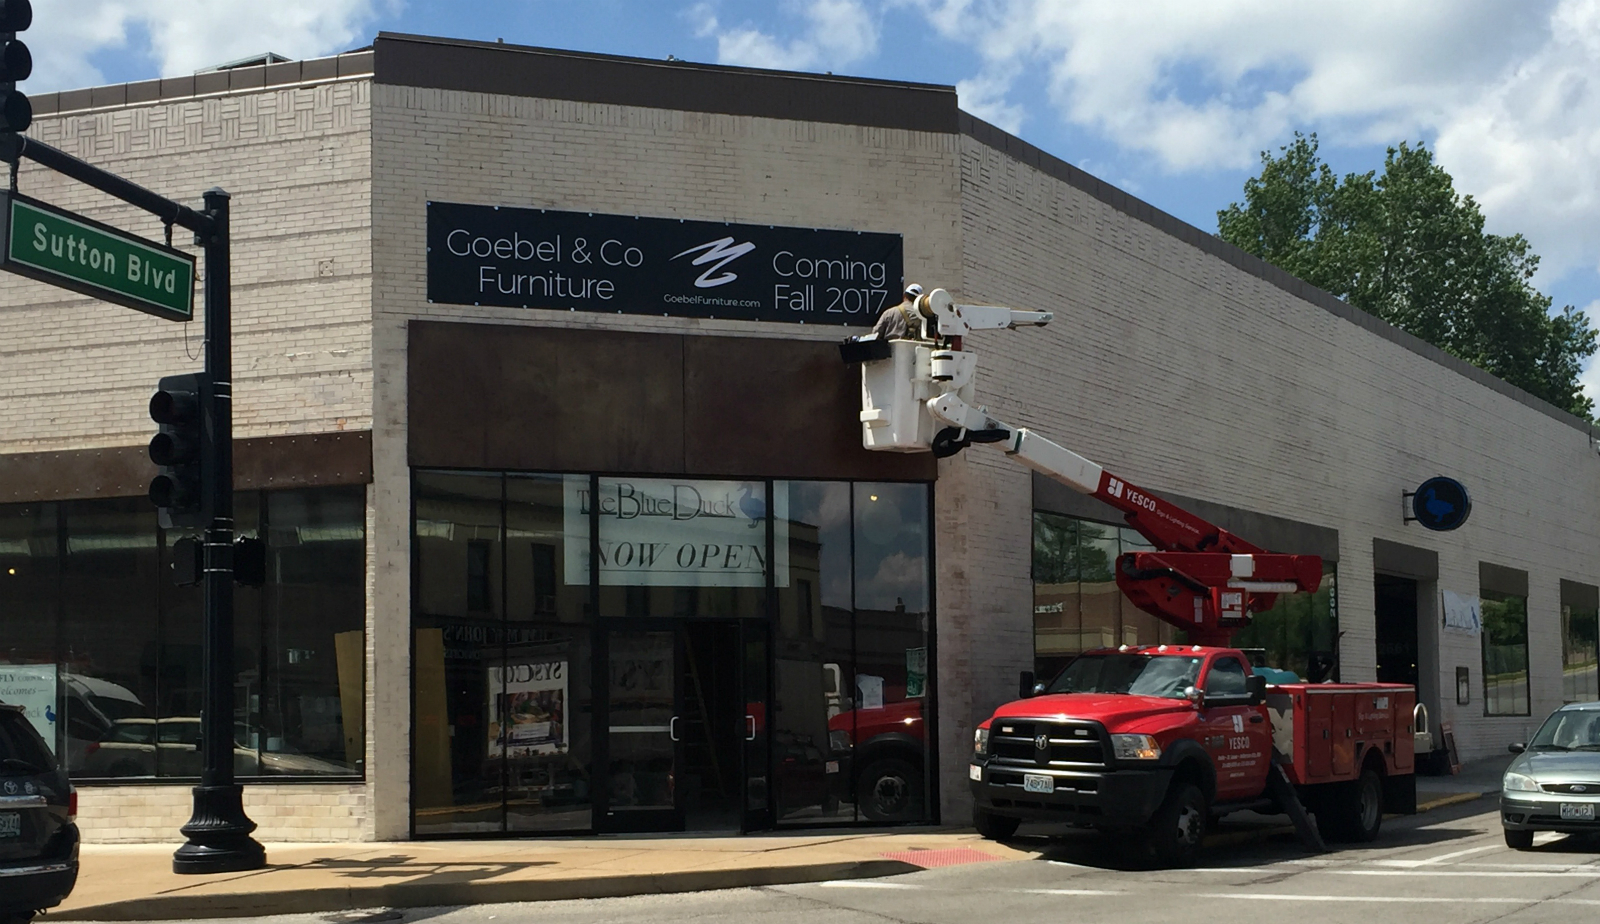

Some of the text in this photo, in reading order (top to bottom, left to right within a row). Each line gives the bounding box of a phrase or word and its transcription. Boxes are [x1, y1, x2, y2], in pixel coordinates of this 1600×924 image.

[32, 222, 176, 295] Sutton Blvd
[446, 229, 644, 267] Goebel & Co
[479, 266, 615, 300] Furniture
[772, 250, 887, 288] Coming
[663, 293, 761, 308] GoebelFurniture.com
[774, 285, 888, 315] Fall 2017
[1126, 488, 1156, 512] YESCO
[586, 541, 766, 568] NOW OPEN
[0, 686, 37, 696] elcomes
[1228, 736, 1250, 750] YESCO
